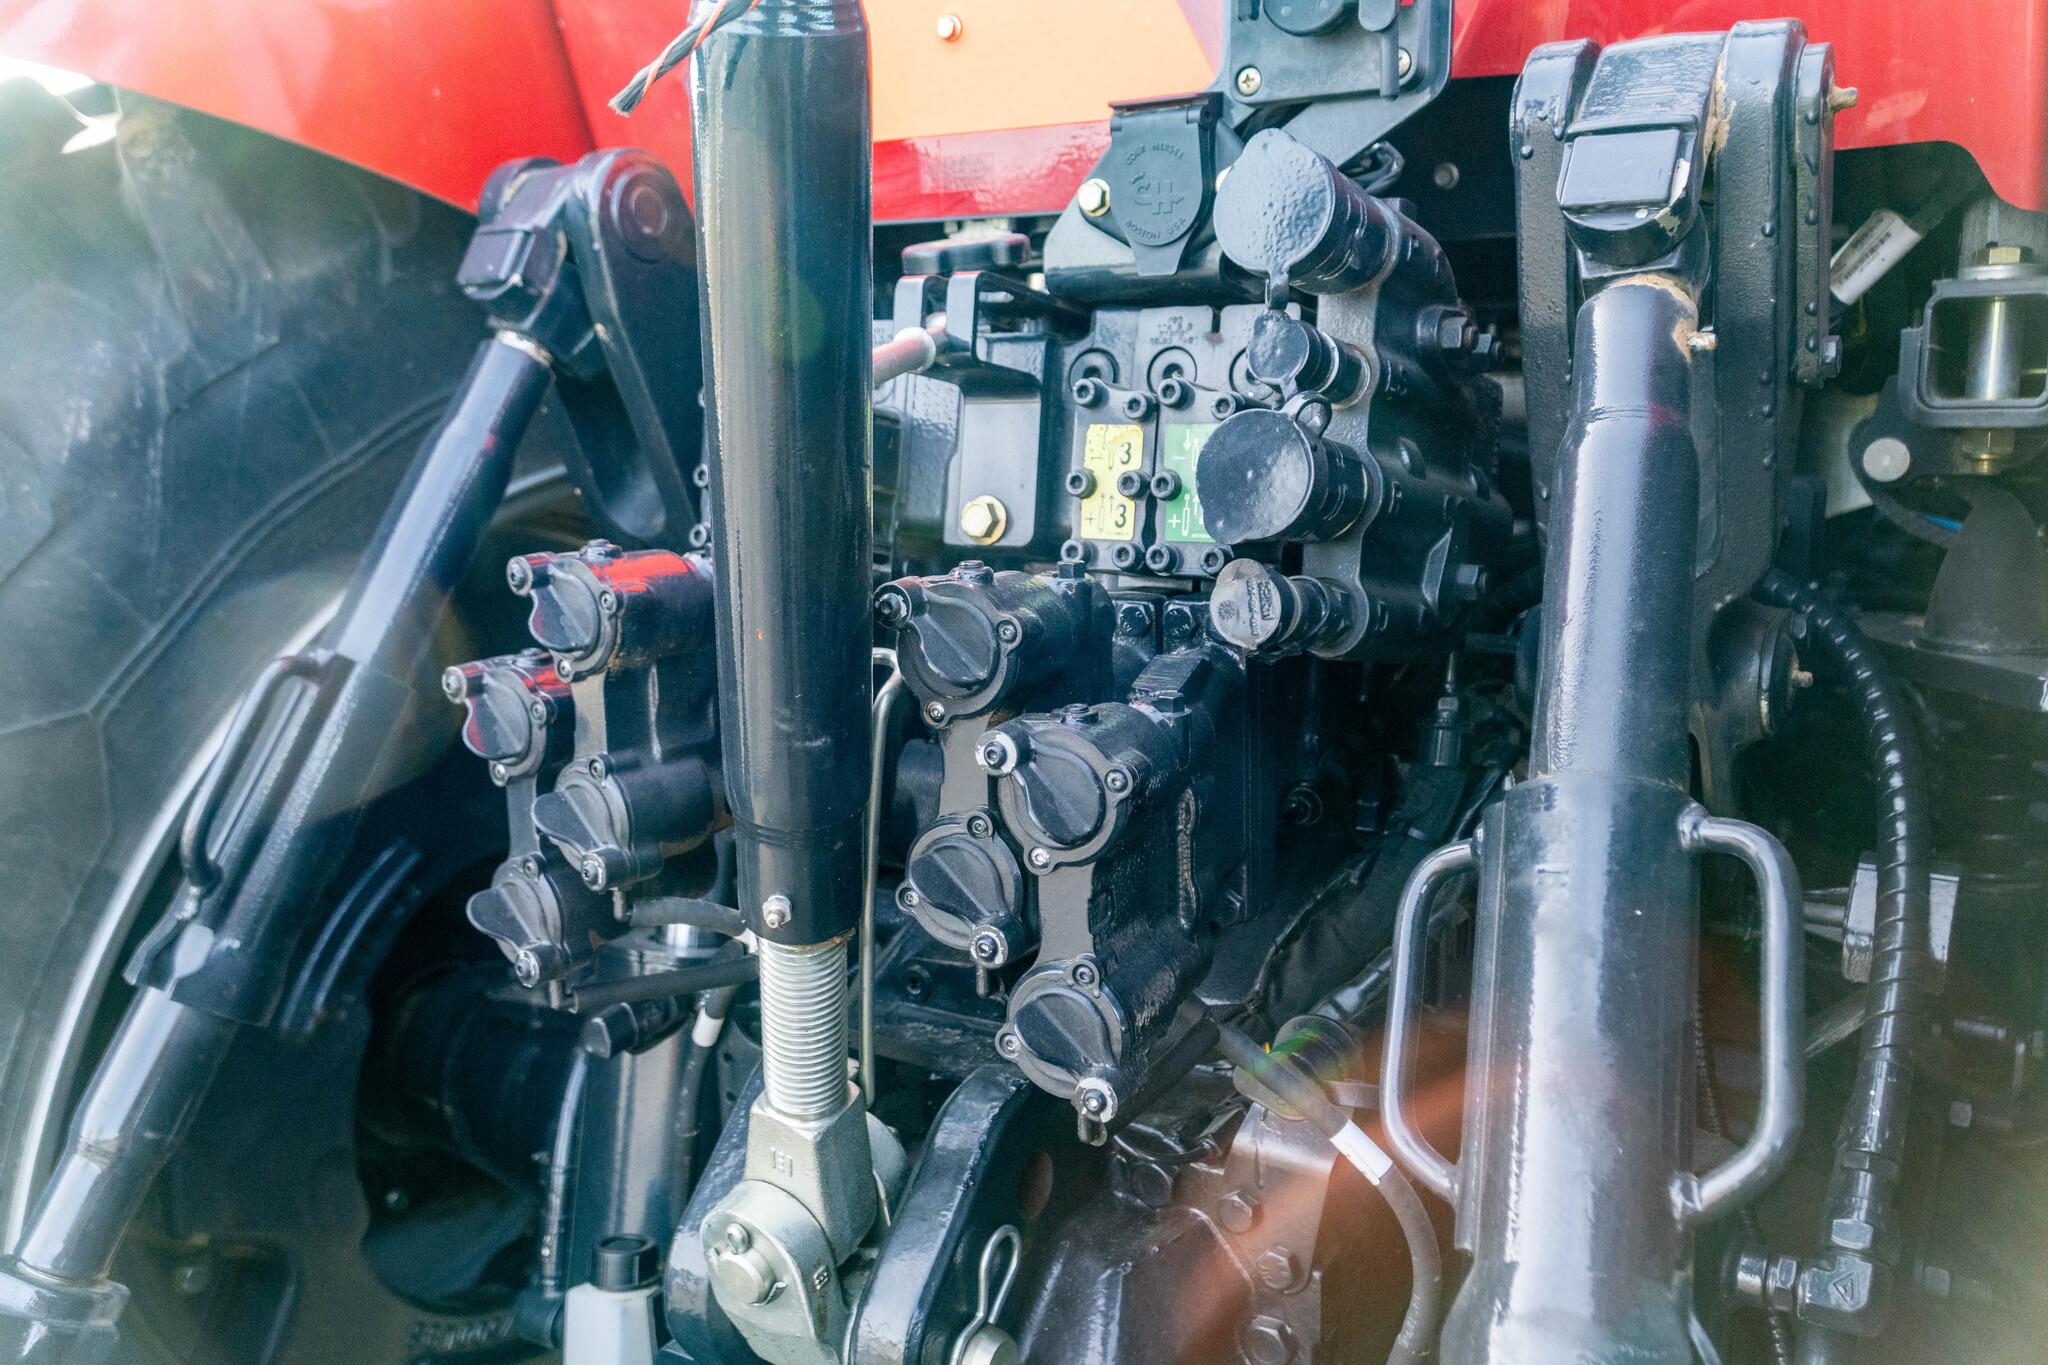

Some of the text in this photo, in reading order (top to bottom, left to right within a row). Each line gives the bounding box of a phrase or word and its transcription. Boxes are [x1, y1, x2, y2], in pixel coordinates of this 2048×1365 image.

[1151, 142, 1186, 160] HERSEE
[1125, 217, 1188, 240] BOSTON USA
[1120, 442, 1132, 465] 3
[1115, 504, 1127, 528] 3
